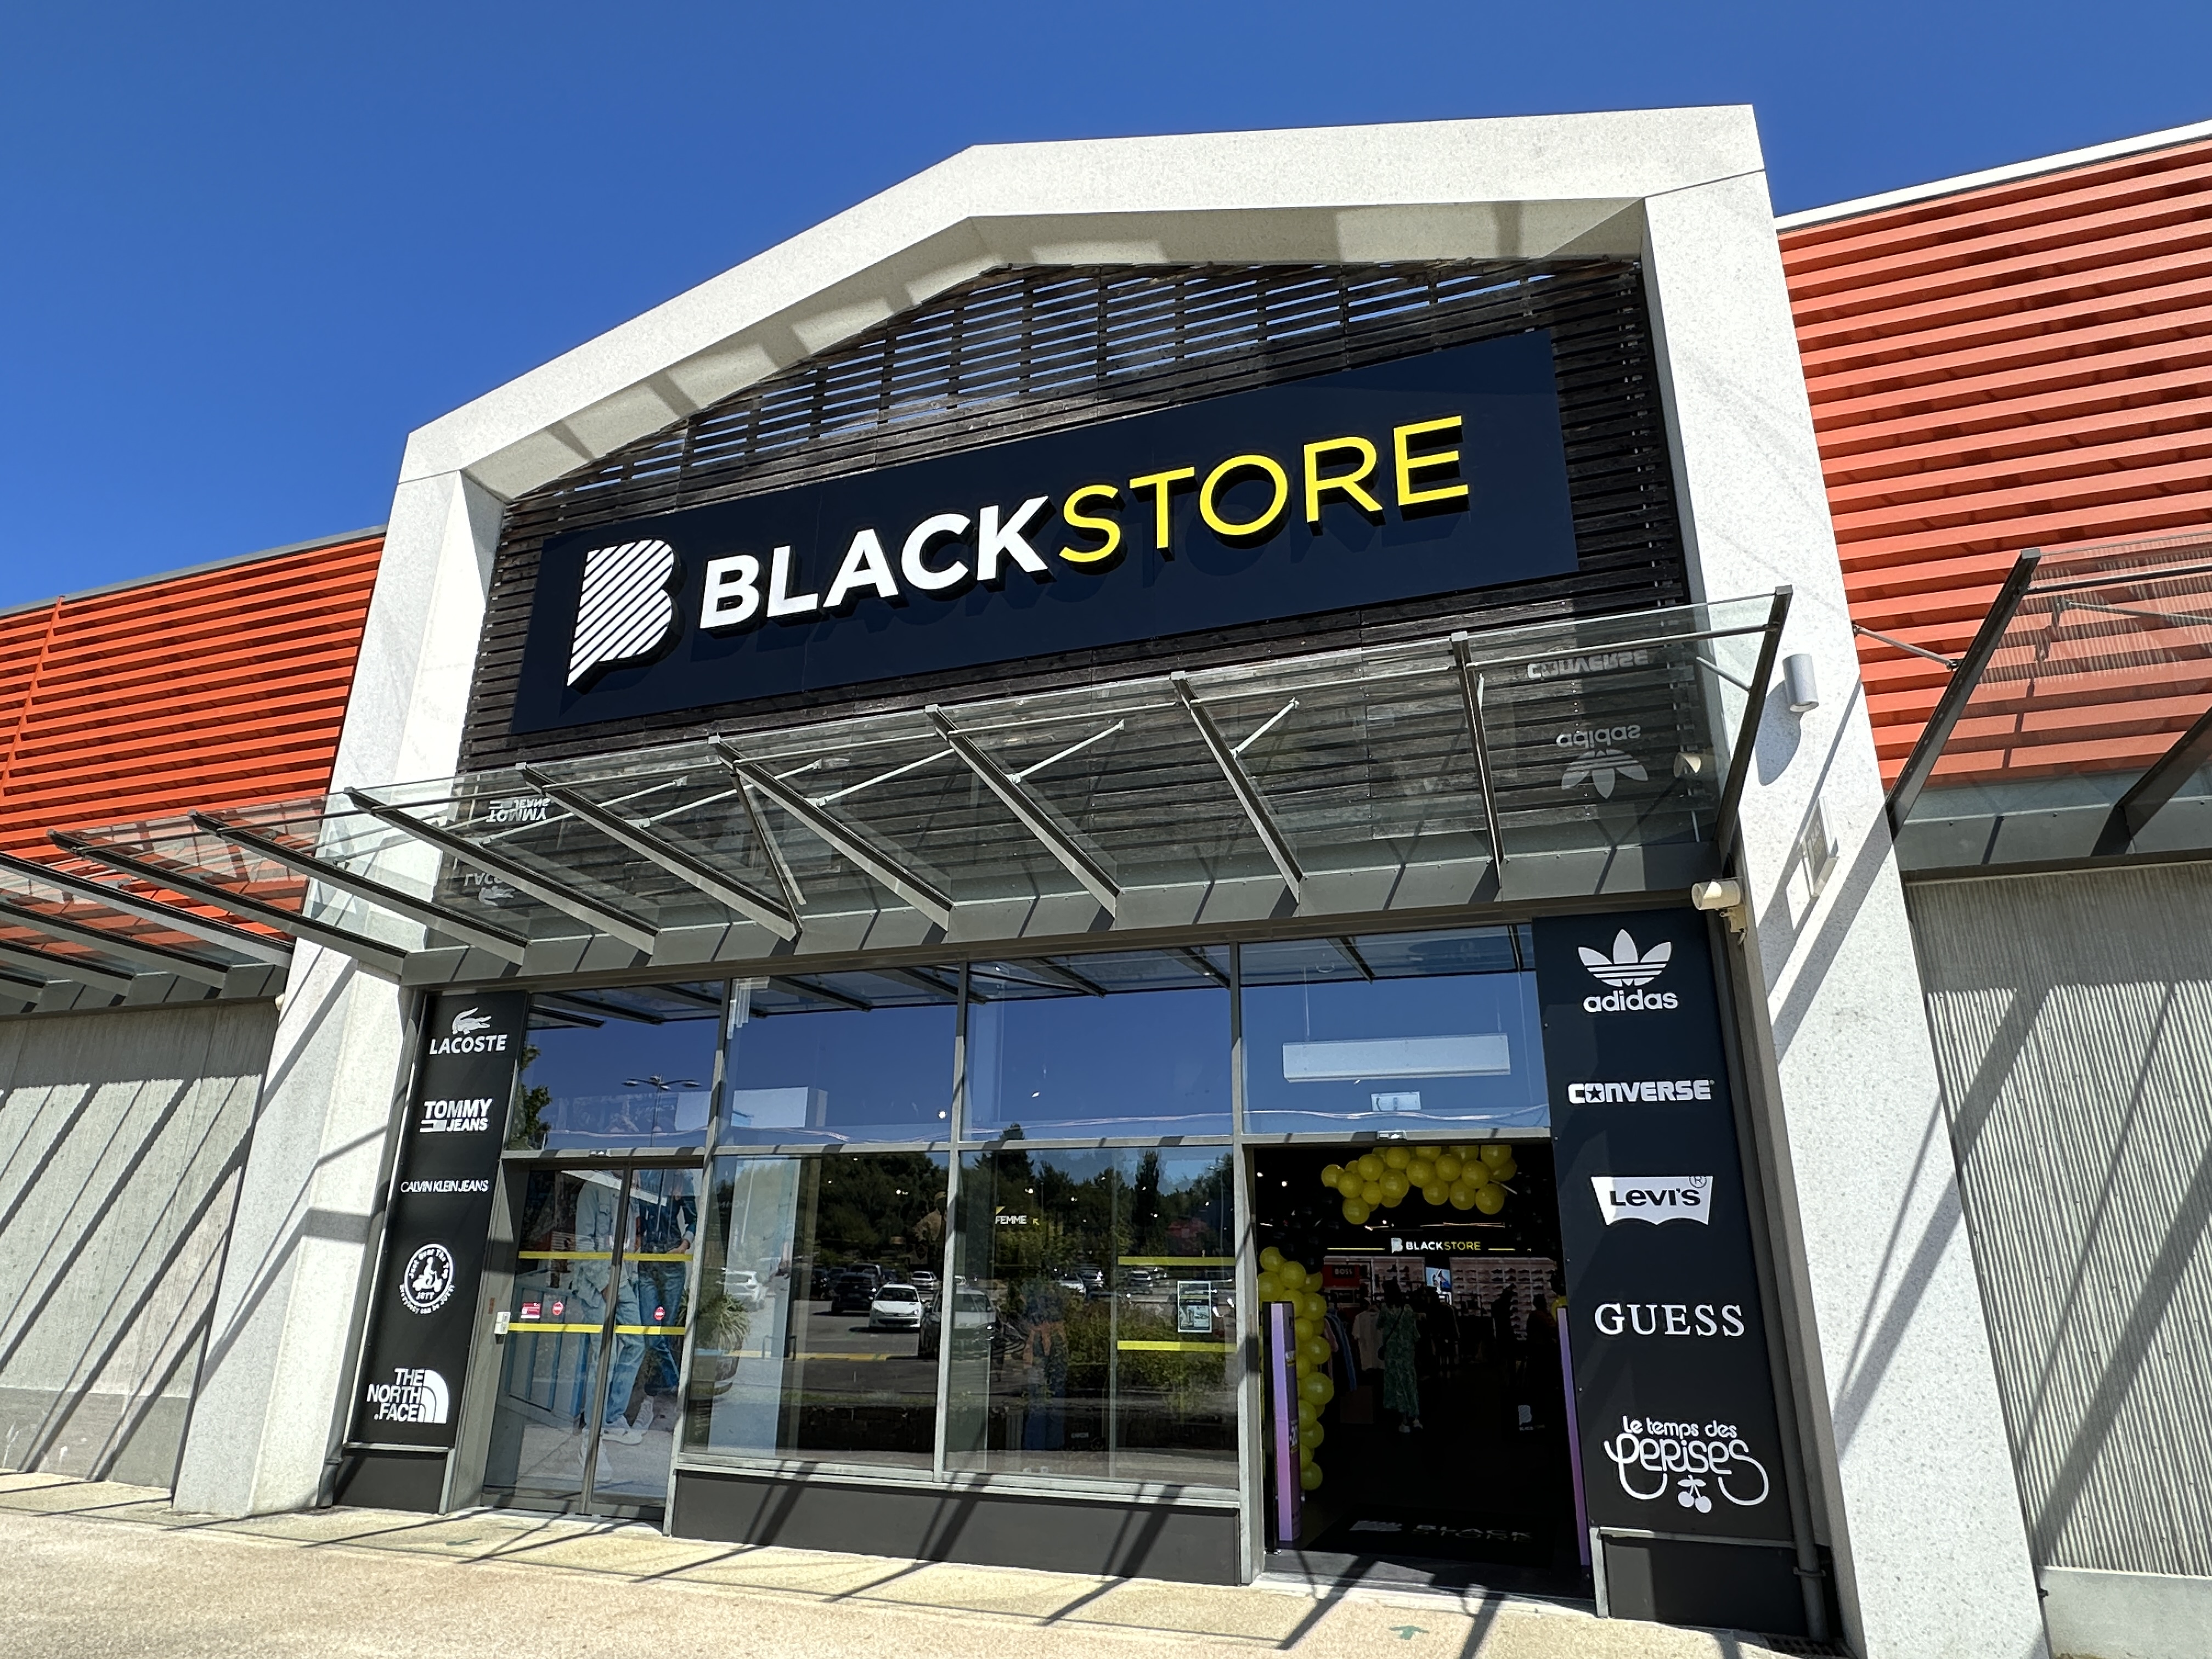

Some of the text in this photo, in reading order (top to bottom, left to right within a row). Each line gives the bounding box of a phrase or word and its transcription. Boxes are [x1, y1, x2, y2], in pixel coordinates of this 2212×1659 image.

[699, 415, 1469, 629] BLACKSTORE
[1583, 989, 1679, 1013] adidas
[429, 1034, 507, 1054] LACOSTE
[1568, 1080, 1712, 1104] CONVERSE
[424, 1098, 493, 1119] TOMMY
[447, 1117, 488, 1132] JEANS
[400, 1180, 489, 1193] CALVIN KLEIN JEANS
[995, 1215, 1027, 1224] FEMME
[1406, 1241, 1481, 1250] BLACKSTORE
[1594, 1302, 1745, 1336] GUESS
[394, 1368, 425, 1386] THE
[366, 1384, 422, 1404] NORTH
[1646, 1417, 1700, 1440] temps
[1704, 1420, 1737, 1438] des
